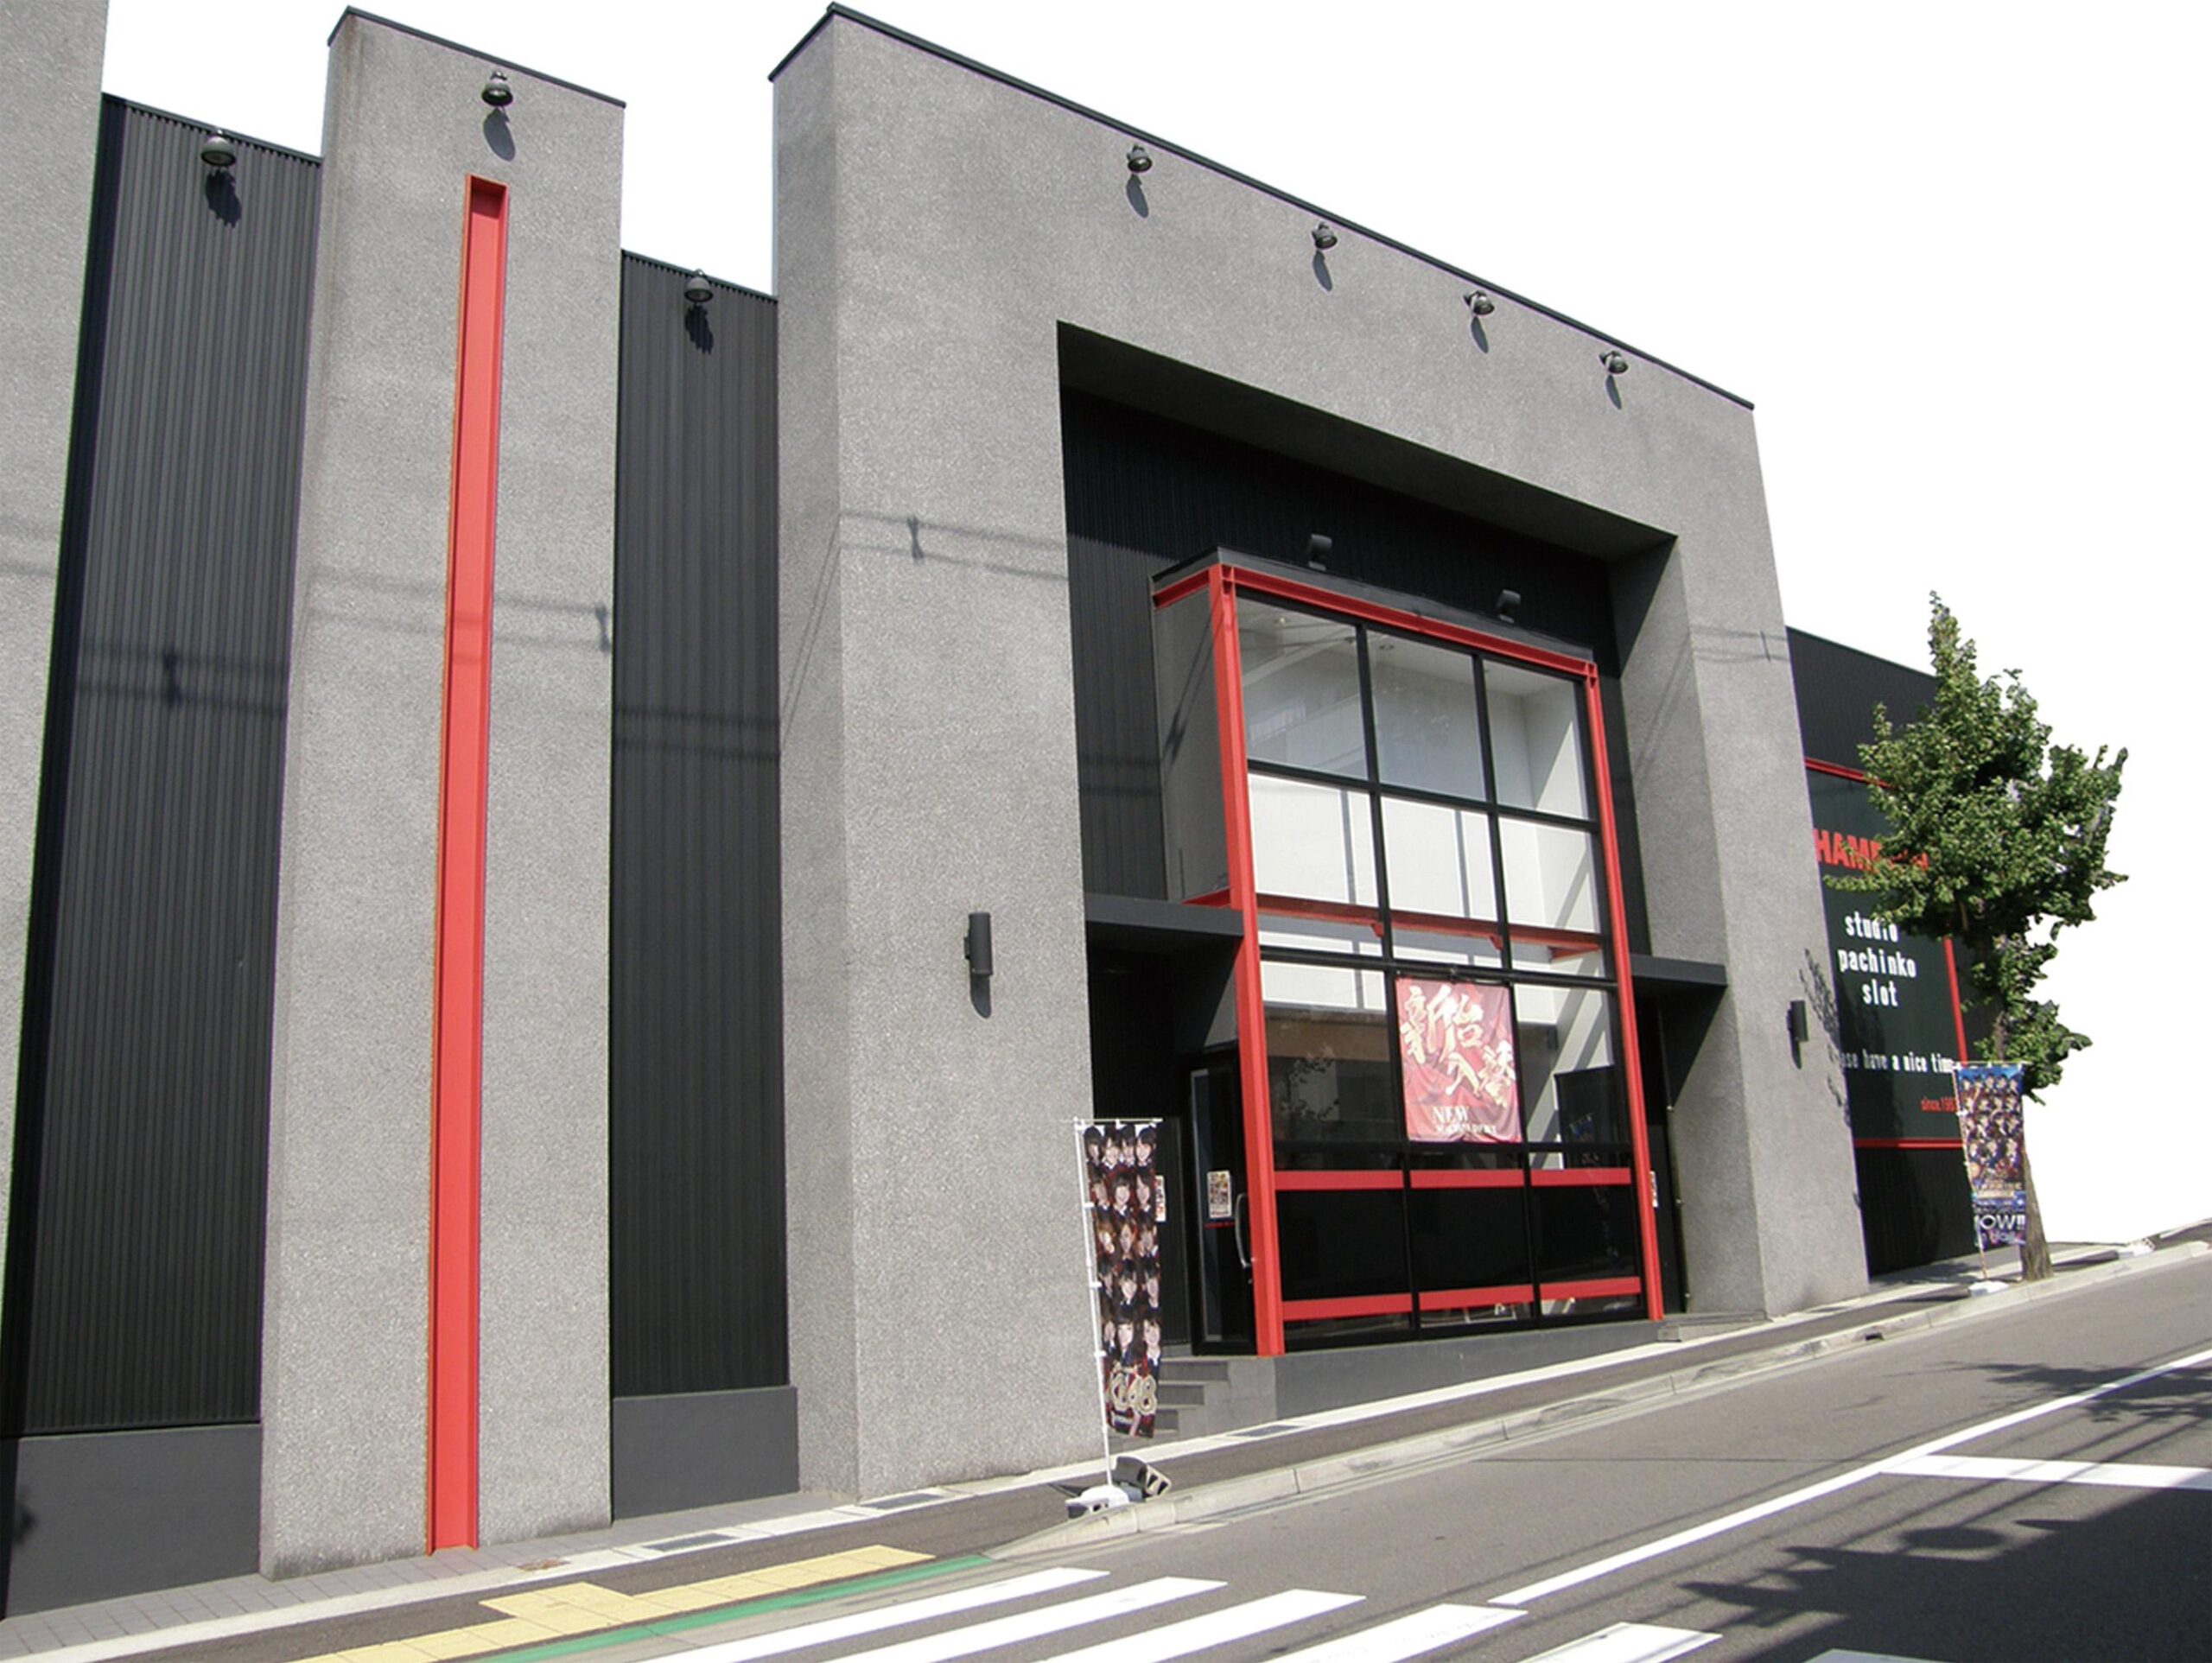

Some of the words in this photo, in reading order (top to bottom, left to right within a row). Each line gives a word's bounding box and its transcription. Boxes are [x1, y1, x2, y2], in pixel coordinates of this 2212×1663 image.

[1845, 911, 1899, 943] studio
[1838, 947, 1917, 978] pachinko
[1862, 979, 1899, 1007] slot
[1862, 1048, 1888, 1070] have
[1891, 1054, 1901, 1071] a
[1903, 1050, 1928, 1073] nice
[1931, 1052, 1955, 1074] tim
